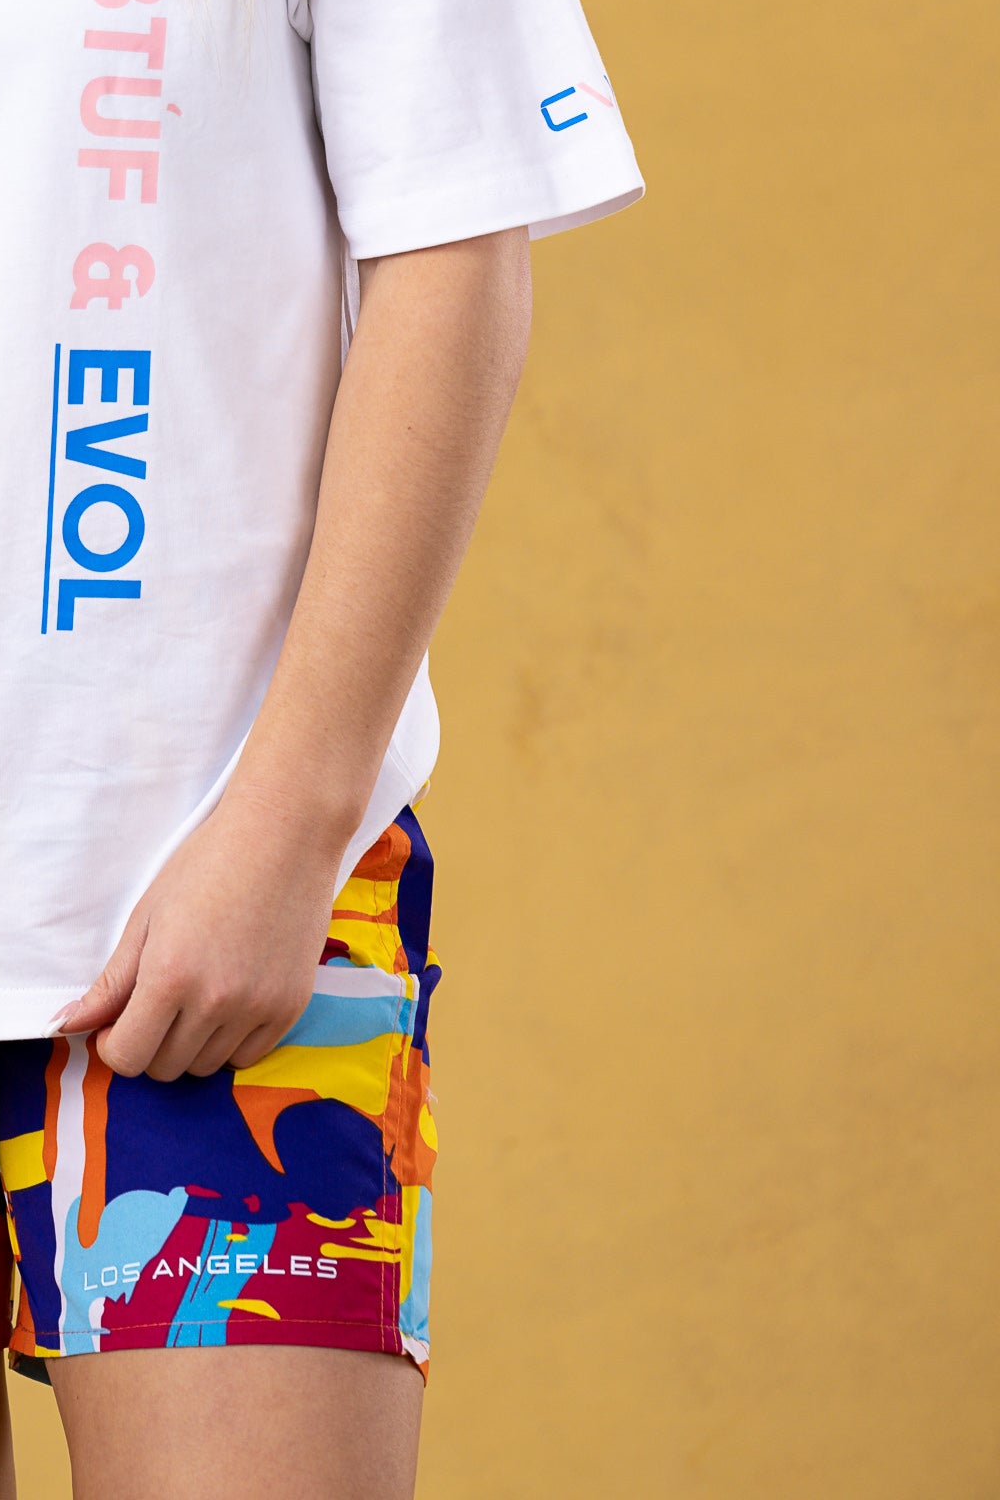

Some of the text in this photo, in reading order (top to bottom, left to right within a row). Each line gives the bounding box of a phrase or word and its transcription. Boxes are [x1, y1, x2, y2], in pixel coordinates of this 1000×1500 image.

[69, 241, 156, 311] &
[56, 349, 152, 632] EVOL
[83, 1254, 338, 1291] LOS ANGELES
